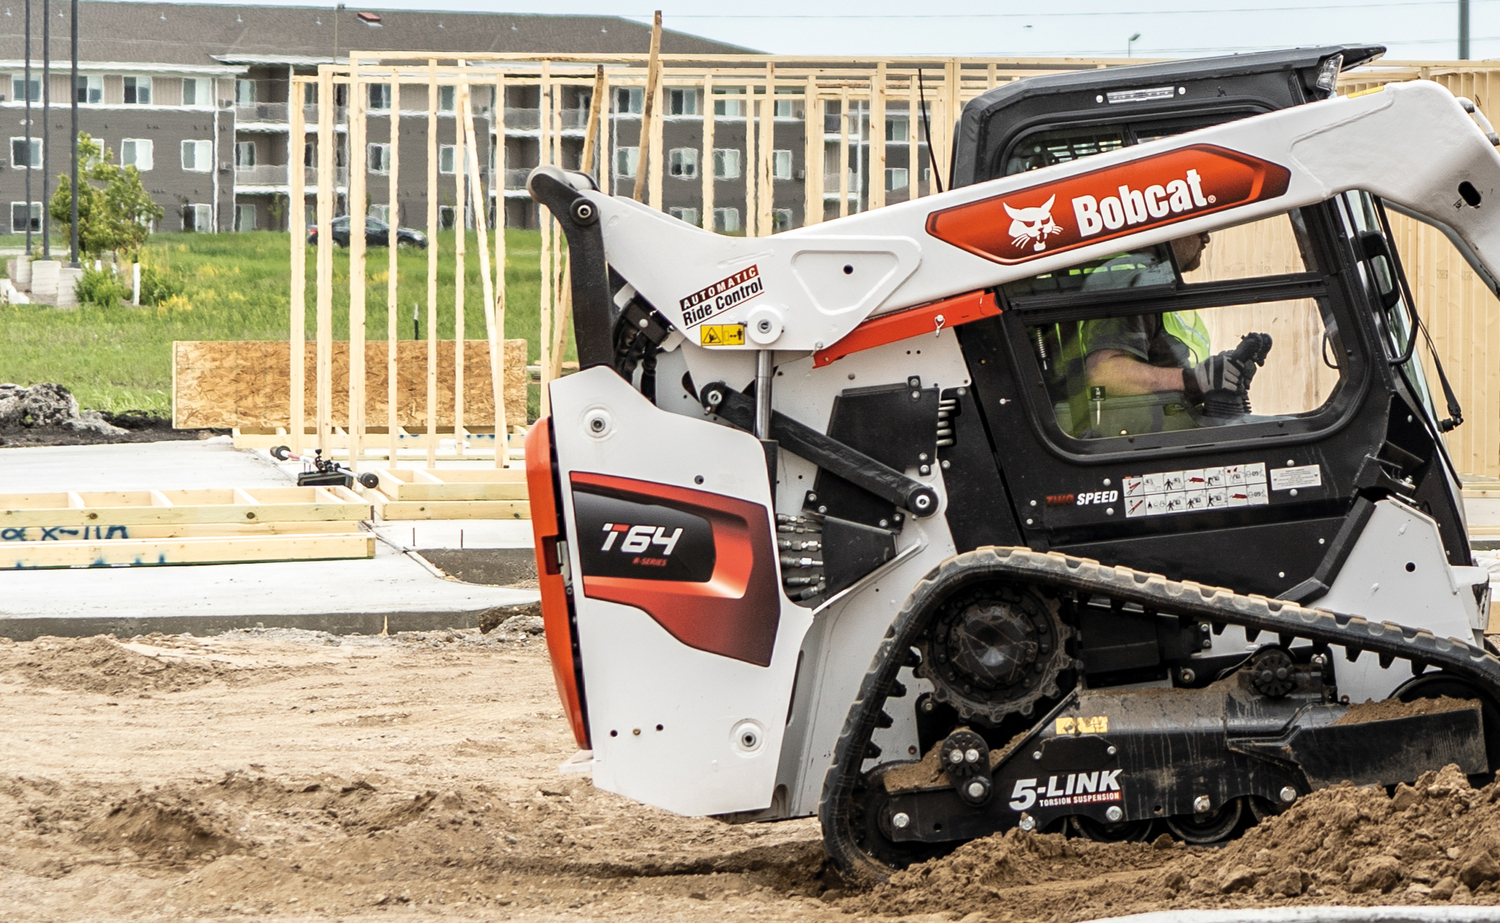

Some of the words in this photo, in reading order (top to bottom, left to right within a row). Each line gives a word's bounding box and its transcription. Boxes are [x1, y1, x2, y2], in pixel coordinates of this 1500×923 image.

[683, 304, 713, 326] Ride
[715, 277, 763, 310] Control
[684, 267, 757, 309] AUTOMATIC
[1046, 494, 1074, 507] TWO
[1077, 490, 1118, 506] SPEED
[601, 523, 683, 555] T64
[632, 557, 668, 567] R-SERIES
[1009, 769, 1123, 811] 5-LINK
[1039, 796, 1072, 807] TORSION
[1073, 792, 1119, 804] SUSPENSION
